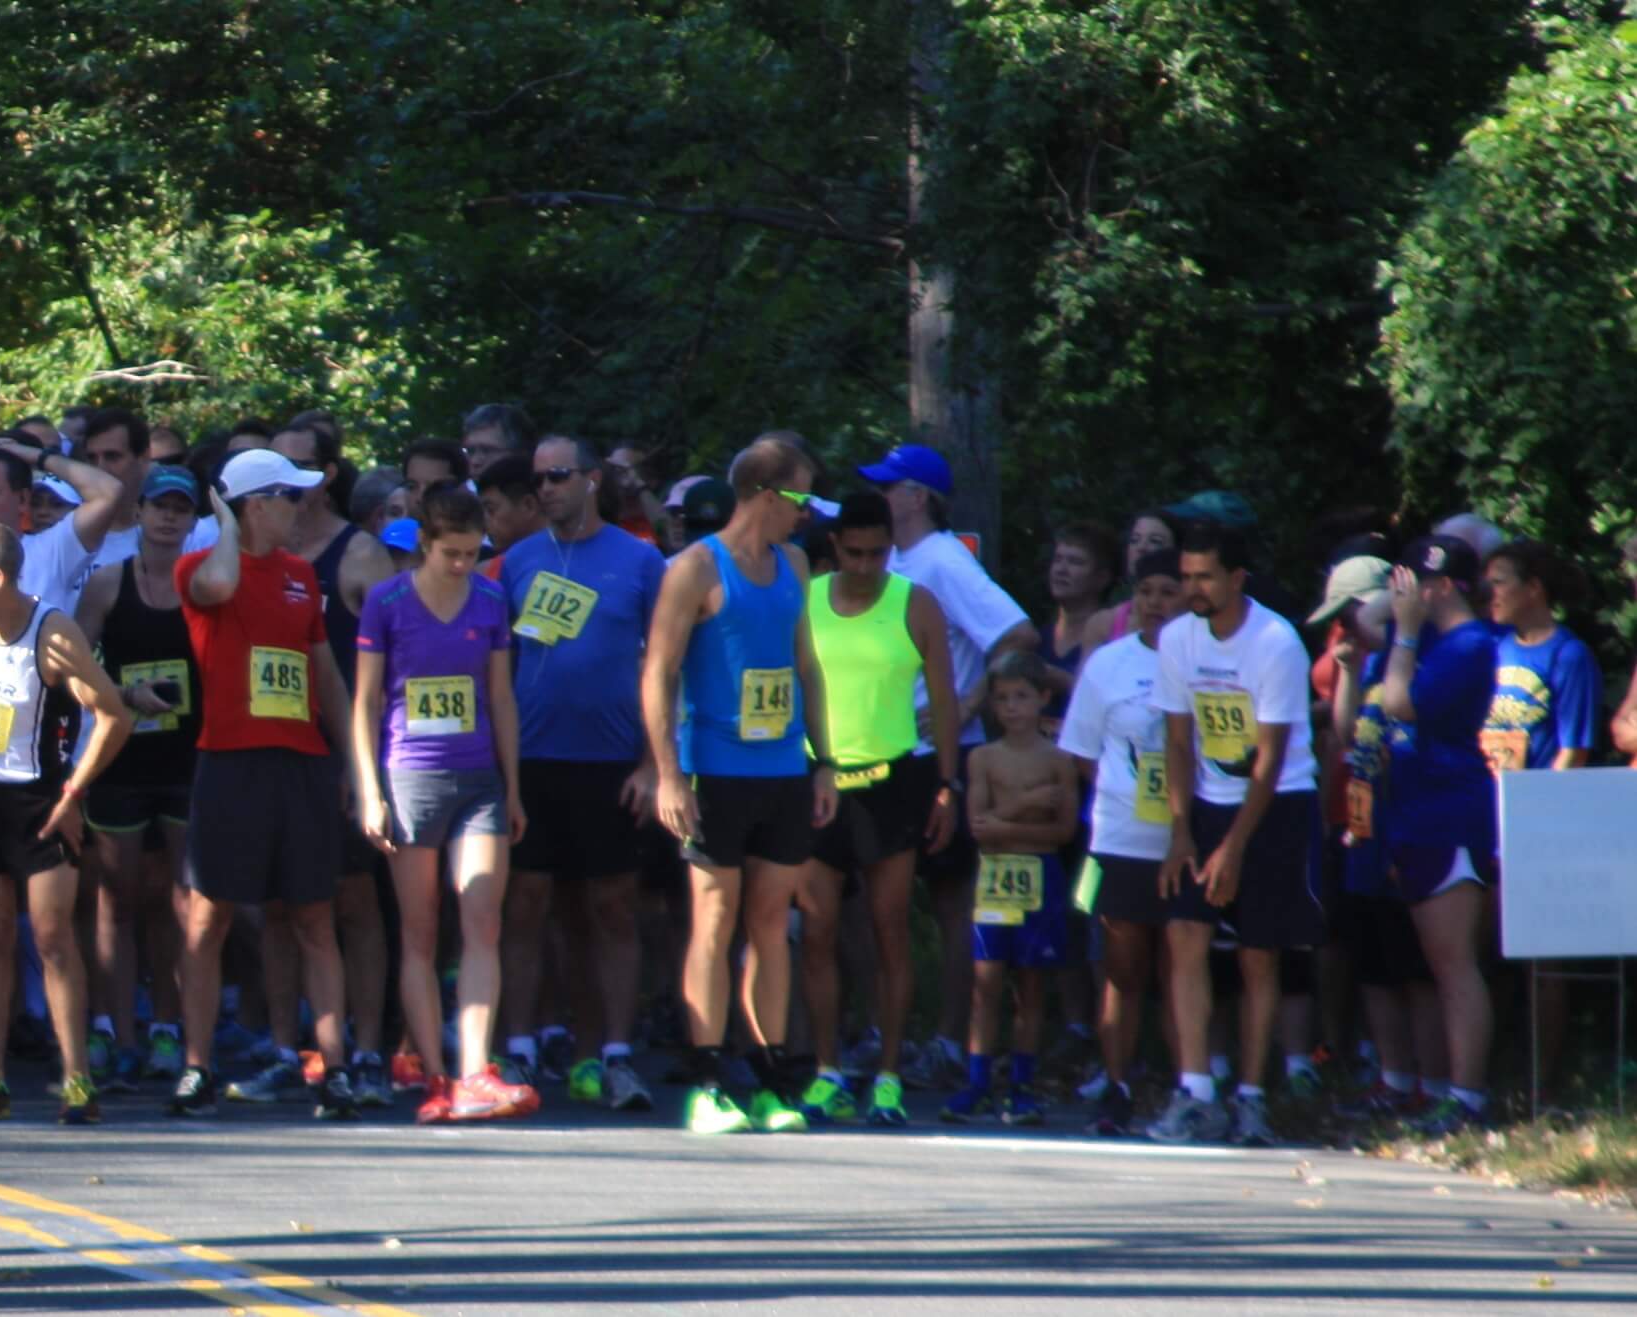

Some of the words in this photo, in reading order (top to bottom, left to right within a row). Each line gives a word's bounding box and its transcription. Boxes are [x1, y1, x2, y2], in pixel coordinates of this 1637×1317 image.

[533, 588, 581, 622] 102
[262, 663, 301, 691] 485
[418, 690, 465, 719] 438
[1204, 704, 1244, 731] 539
[986, 868, 1031, 895] 149
